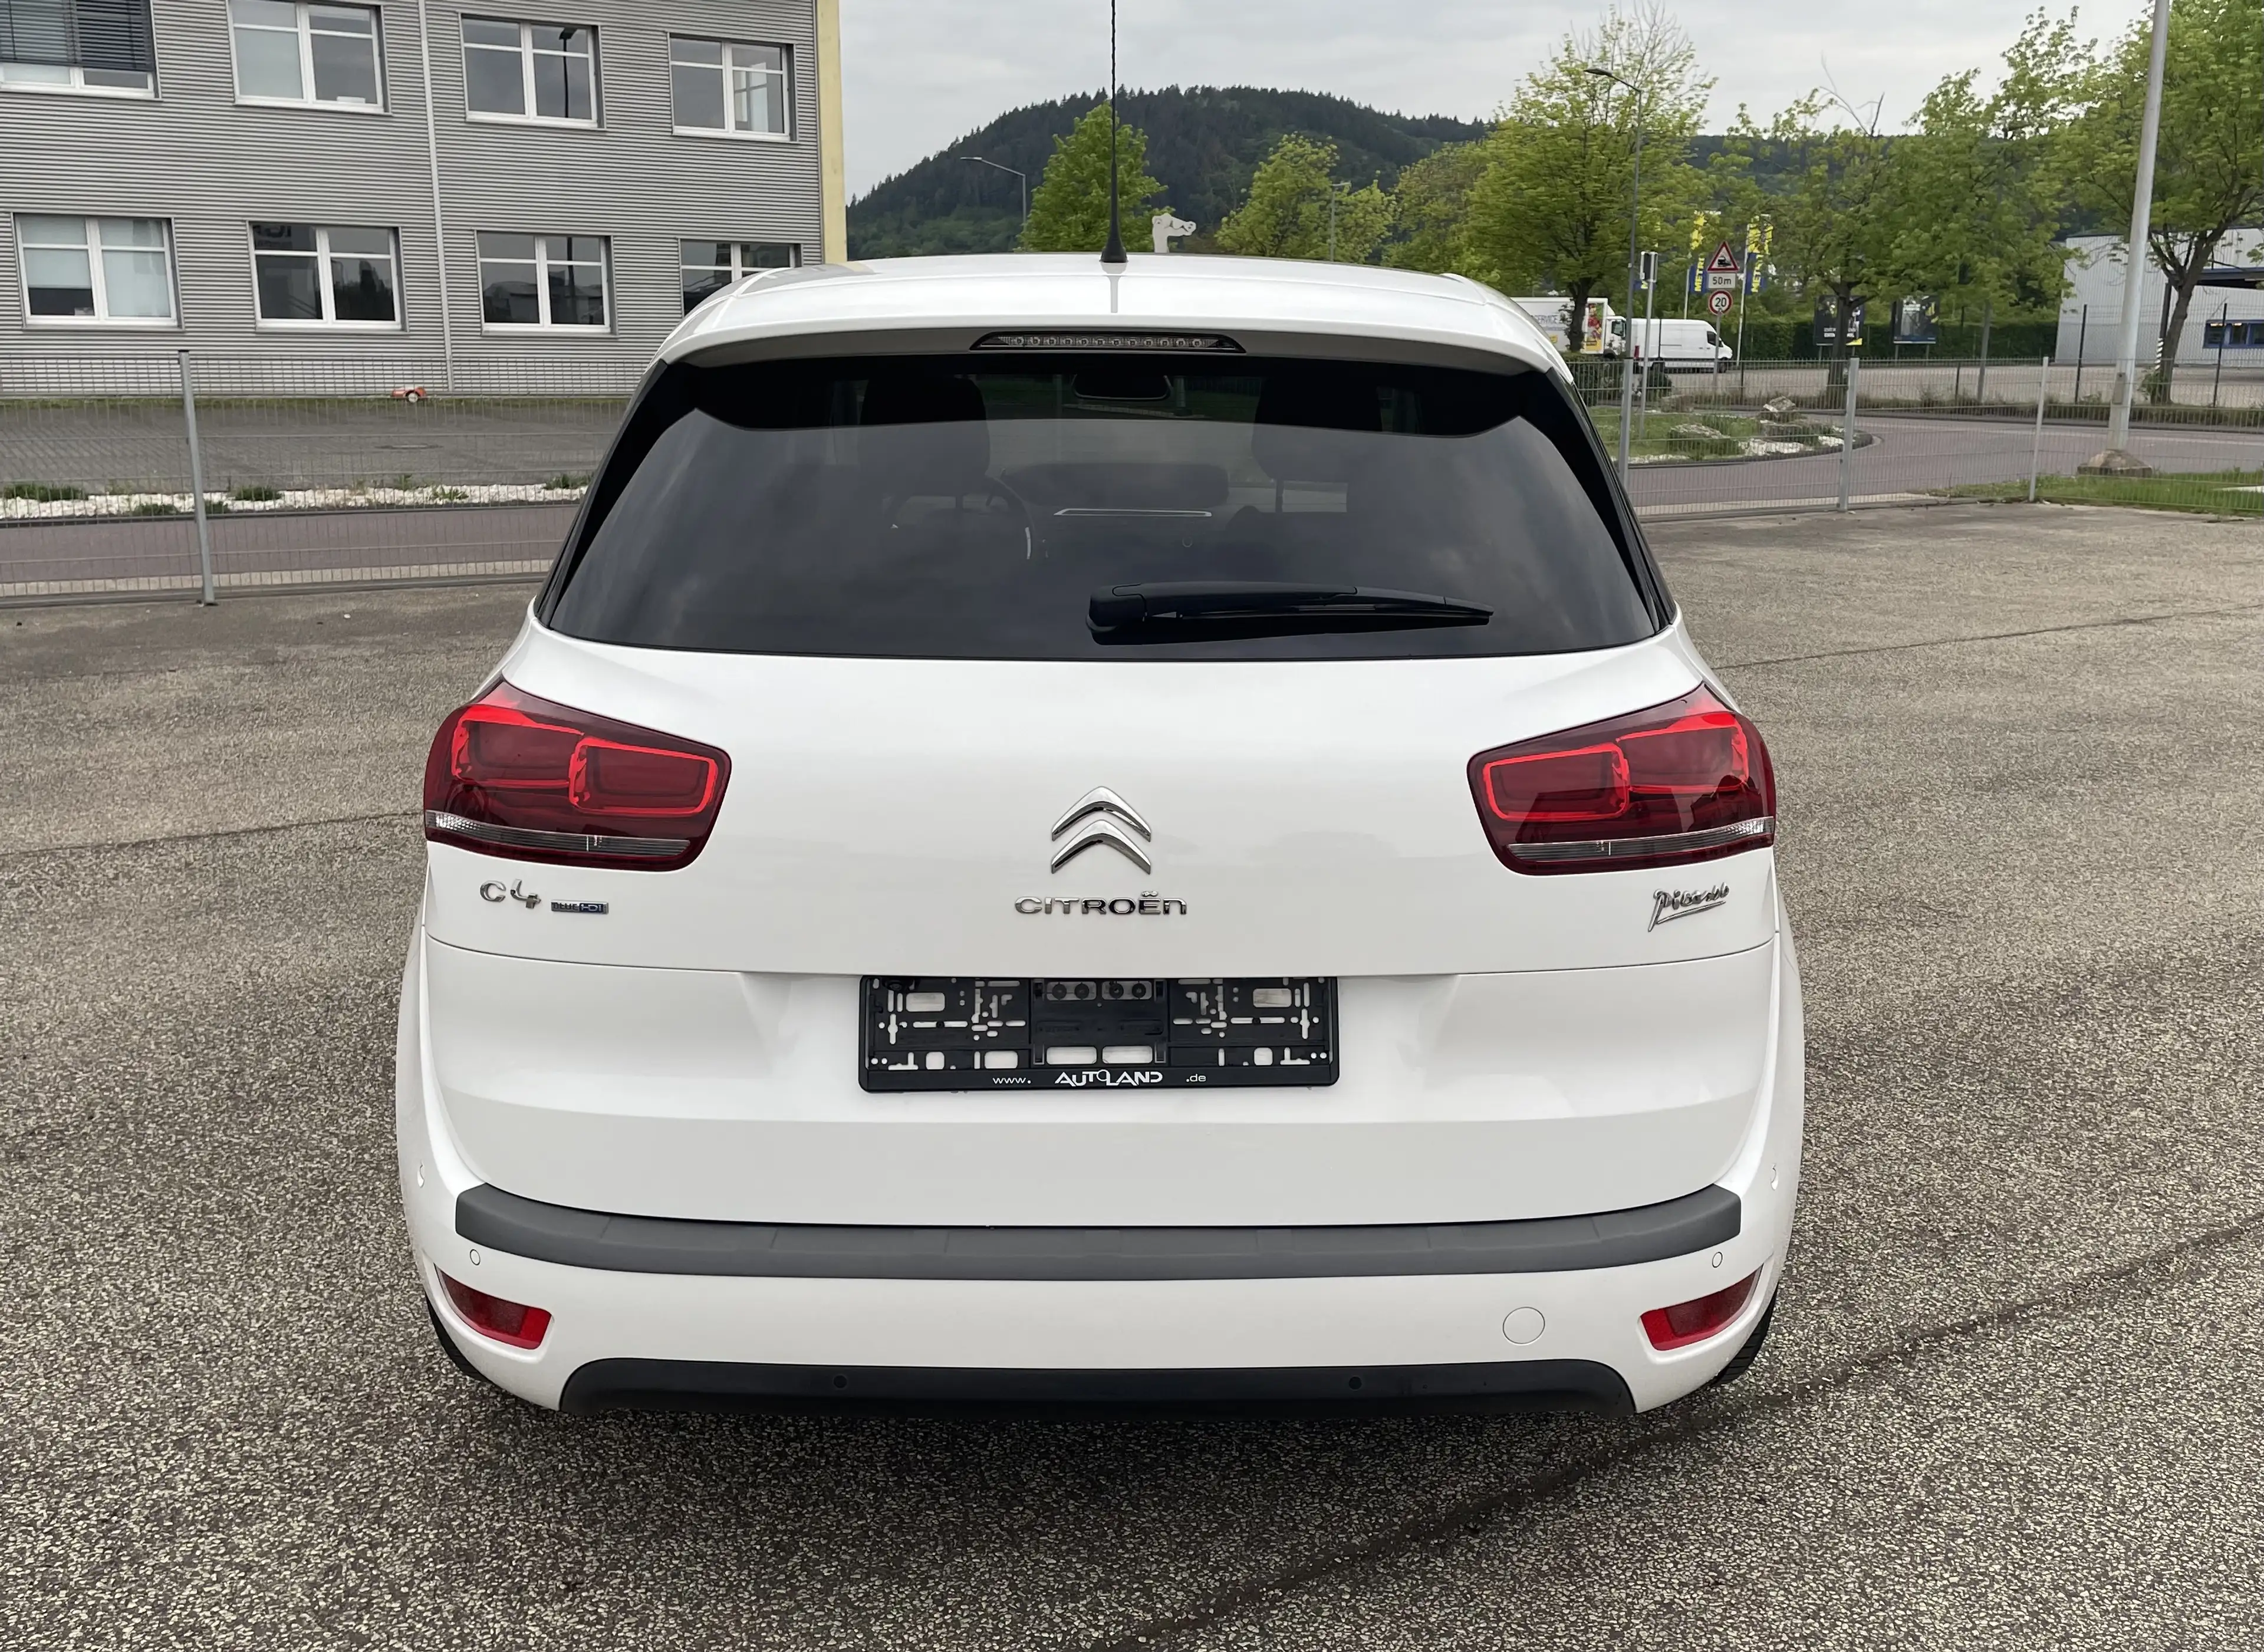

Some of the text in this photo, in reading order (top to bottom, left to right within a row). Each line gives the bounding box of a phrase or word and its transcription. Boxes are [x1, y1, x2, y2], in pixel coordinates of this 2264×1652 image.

[1712, 276, 1732, 285] 50m
[1715, 297, 1727, 307] 20
[479, 878, 541, 909] C4
[1055, 1069, 1163, 1087] AUTOLAND
